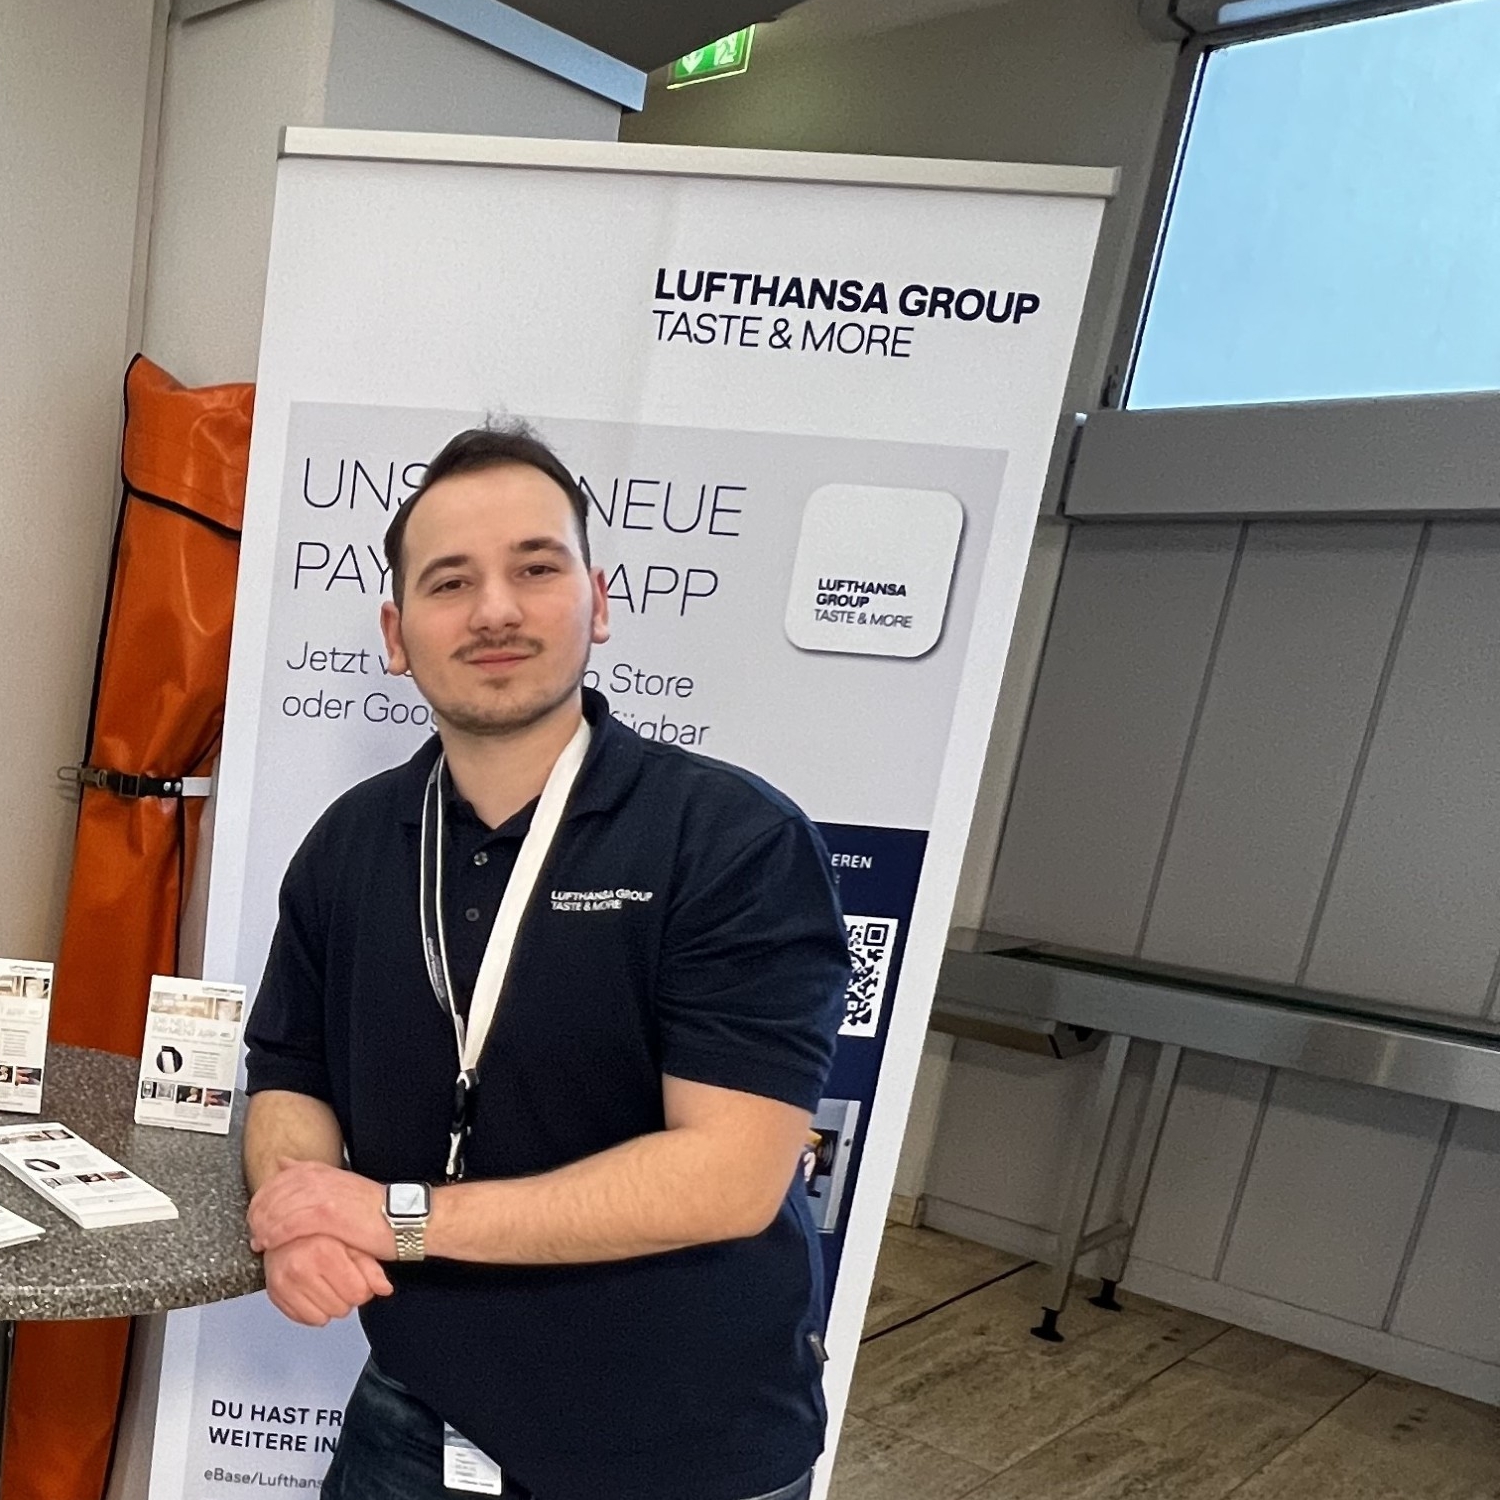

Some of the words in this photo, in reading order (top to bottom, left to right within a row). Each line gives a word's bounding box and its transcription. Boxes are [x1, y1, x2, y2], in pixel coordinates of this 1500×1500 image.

[654, 267, 889, 315] LUFTHANSA
[898, 283, 1041, 325] GROUP
[651, 309, 763, 349] TASTE
[767, 317, 793, 350] &
[800, 319, 915, 358] MORE
[302, 457, 430, 512] UNS
[578, 475, 747, 537] NEUE
[294, 541, 392, 595] PAY
[606, 563, 719, 617] APP
[817, 578, 907, 597] LUFTHANSA
[815, 592, 870, 608] GROUP
[813, 608, 856, 625] TASTE
[856, 611, 868, 625] &
[869, 612, 914, 629] MORE
[286, 641, 371, 676] Jetzt
[609, 663, 695, 699] Store
[282, 689, 356, 720] oder
[830, 852, 873, 870] EREN
[550, 890, 614, 901] LUFTHANSA
[615, 888, 653, 902] GROUP
[550, 900, 582, 911] TASTE
[583, 901, 591, 911] &
[592, 899, 622, 911] MORE
[211, 1398, 243, 1420] DU
[250, 1403, 311, 1426] HAST
[315, 1408, 344, 1427] FR
[208, 1425, 308, 1453] WEITERE
[313, 1435, 338, 1454] IN
[203, 1466, 324, 1490] eBase/Lufthans
